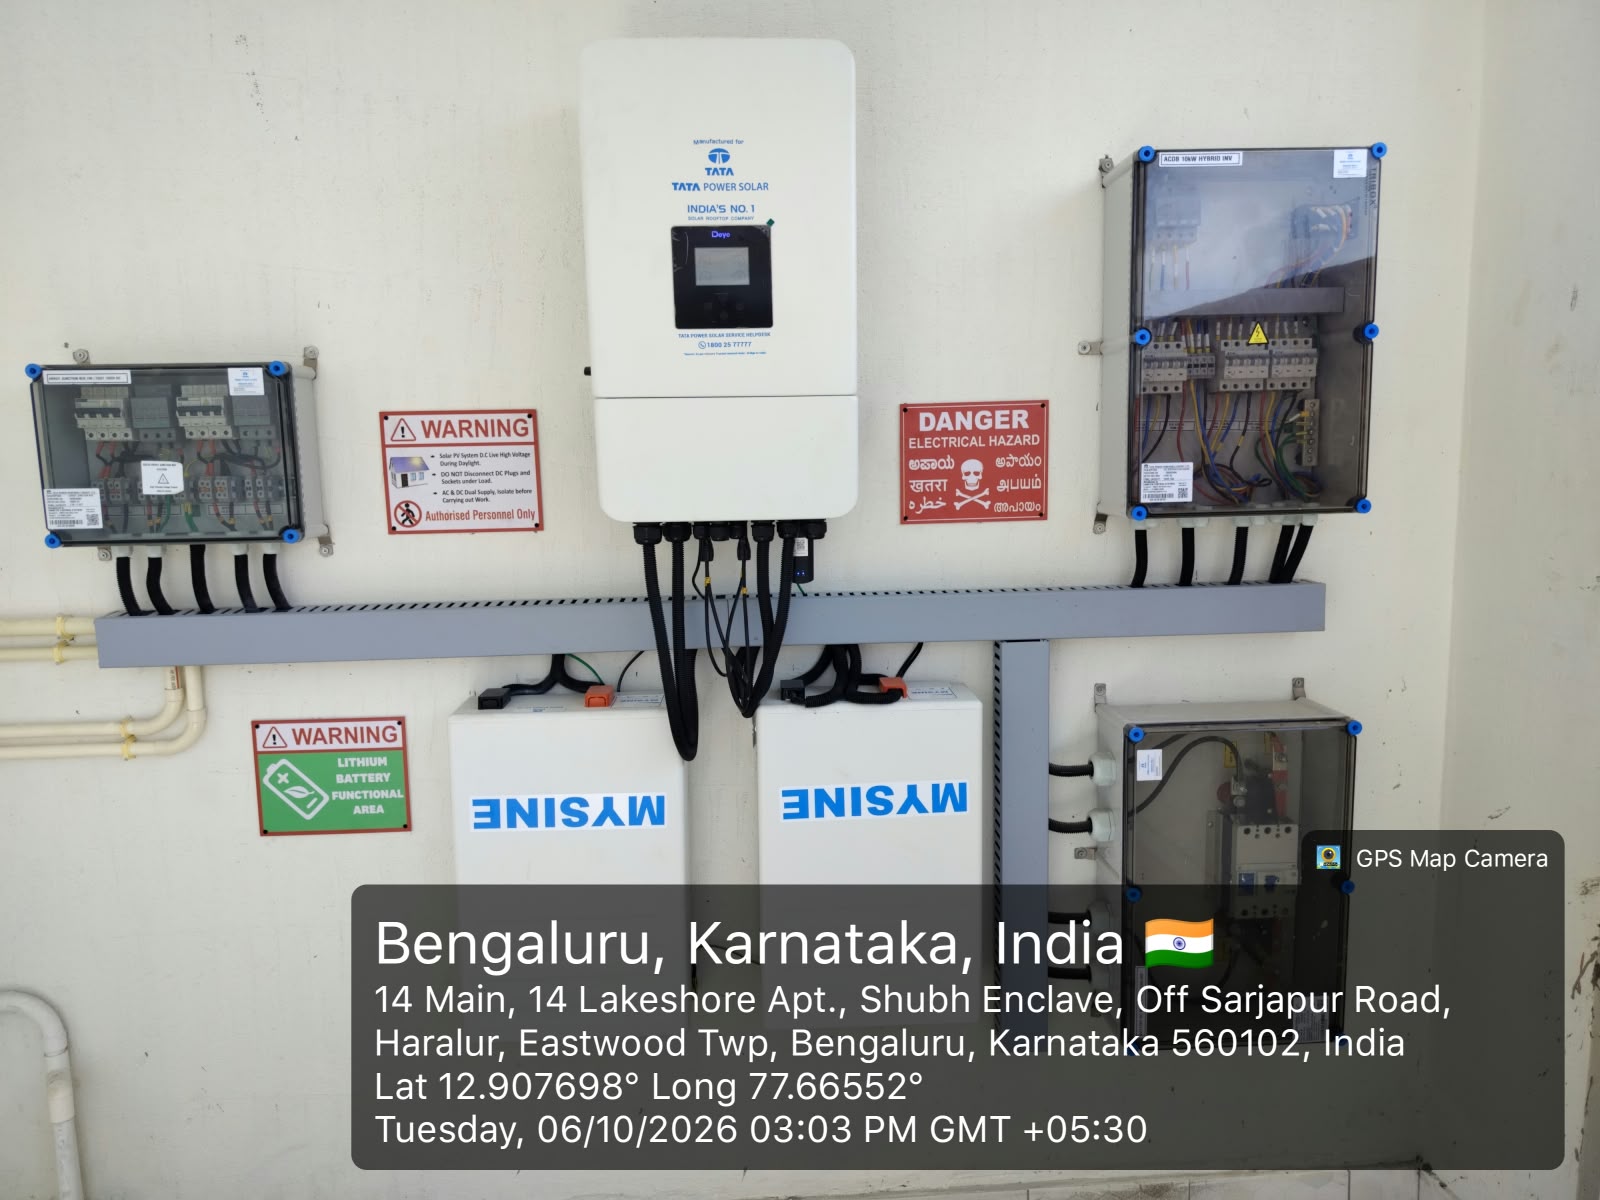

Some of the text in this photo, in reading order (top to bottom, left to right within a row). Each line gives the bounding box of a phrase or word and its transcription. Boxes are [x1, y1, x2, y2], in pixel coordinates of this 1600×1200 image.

[705, 168, 734, 176] TATA
[672, 182, 769, 192] TATA POWER SOLAR
[687, 204, 755, 213] INDIA'S NO. 1
[919, 409, 1029, 432] DANGER
[421, 418, 529, 439] WARNING
[908, 434, 1040, 448] ELECTRICAL HAZARD
[995, 452, 1042, 468] అపాయం
[909, 478, 948, 493] खतरा
[994, 501, 1041, 513] അപായം
[425, 509, 536, 521] Authorised Personnel Only
[292, 725, 398, 745] WARNING
[337, 756, 387, 768] LITHIUM
[336, 772, 391, 784] BATTERY
[332, 789, 404, 800] FUNCTIONAL
[782, 782, 968, 820] MYSINE
[353, 805, 385, 815] AREA
[472, 795, 666, 830] MYSINE
